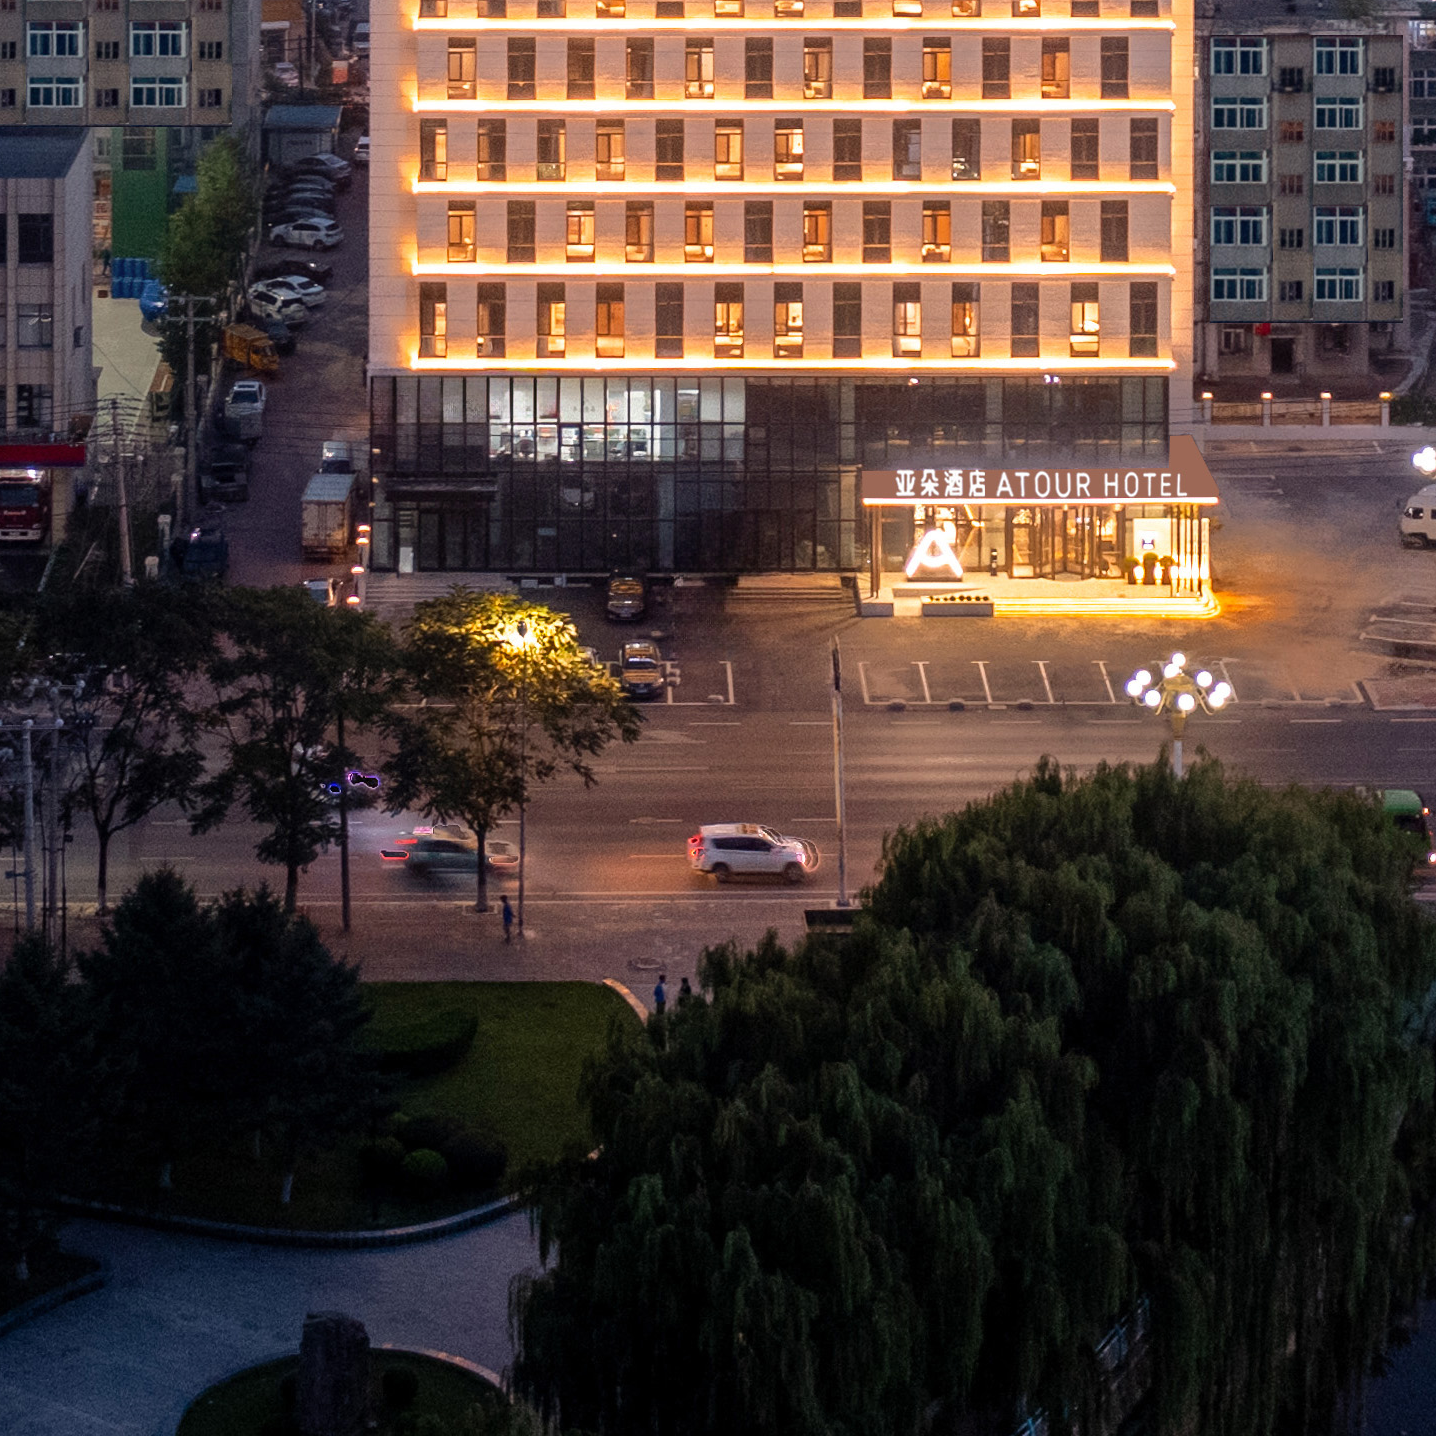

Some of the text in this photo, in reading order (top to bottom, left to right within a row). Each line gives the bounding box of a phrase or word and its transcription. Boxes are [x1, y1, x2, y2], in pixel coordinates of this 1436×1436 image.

[895, 468, 1188, 498] 亚朵酒店 ATOUR HOTEL
